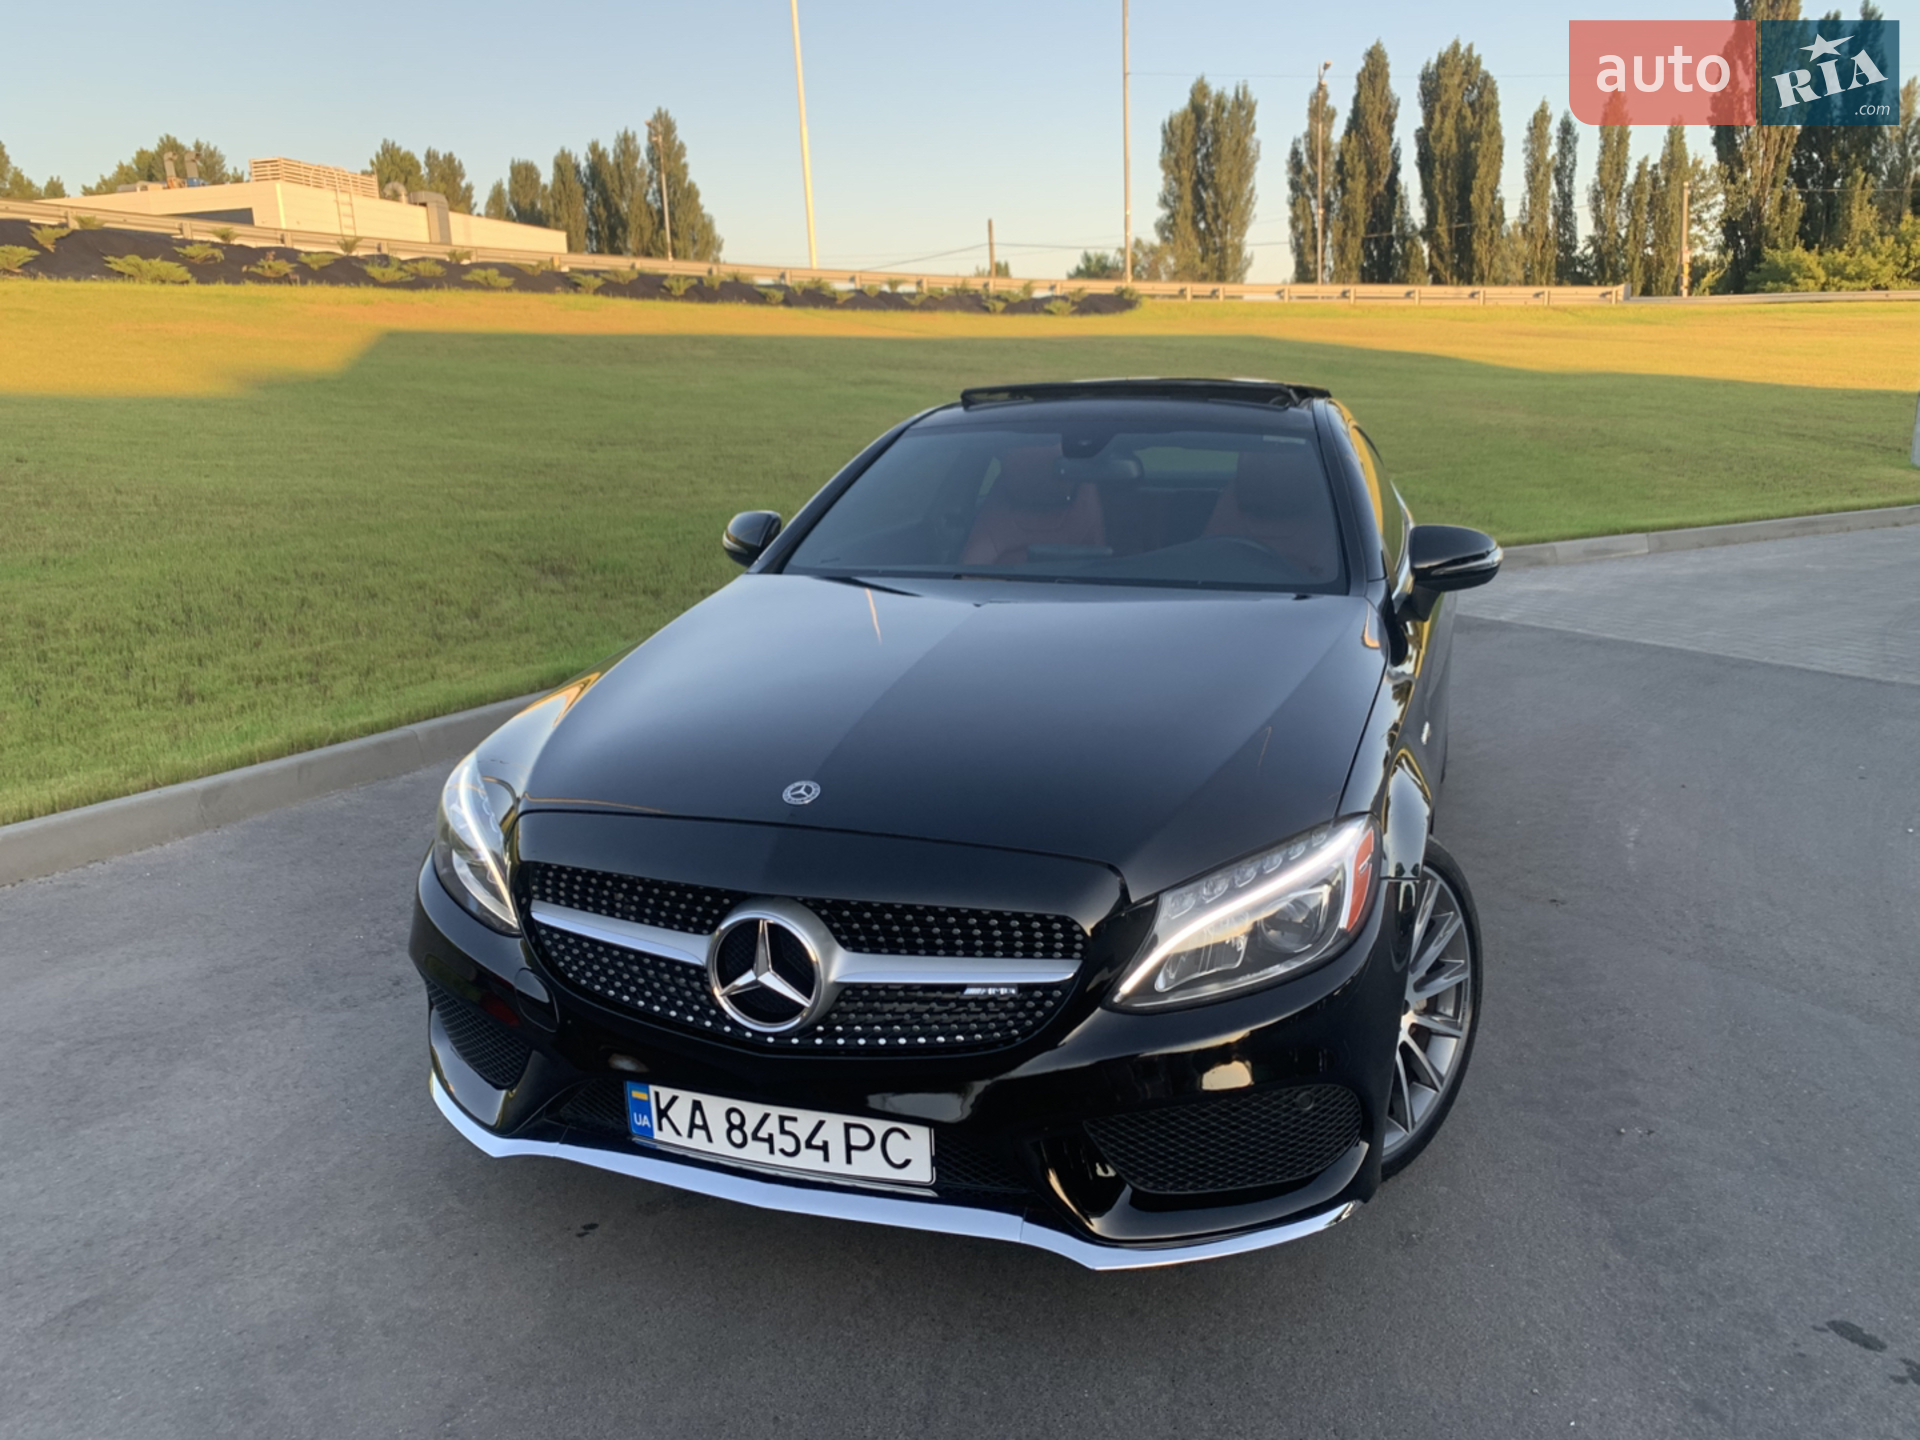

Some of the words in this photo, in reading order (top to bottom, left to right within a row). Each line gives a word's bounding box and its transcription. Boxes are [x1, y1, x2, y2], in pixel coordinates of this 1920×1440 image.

[633, 1112, 651, 1128] UA
[654, 1090, 713, 1144] KA
[724, 1106, 830, 1163] 8454
[843, 1121, 913, 1169] PC
